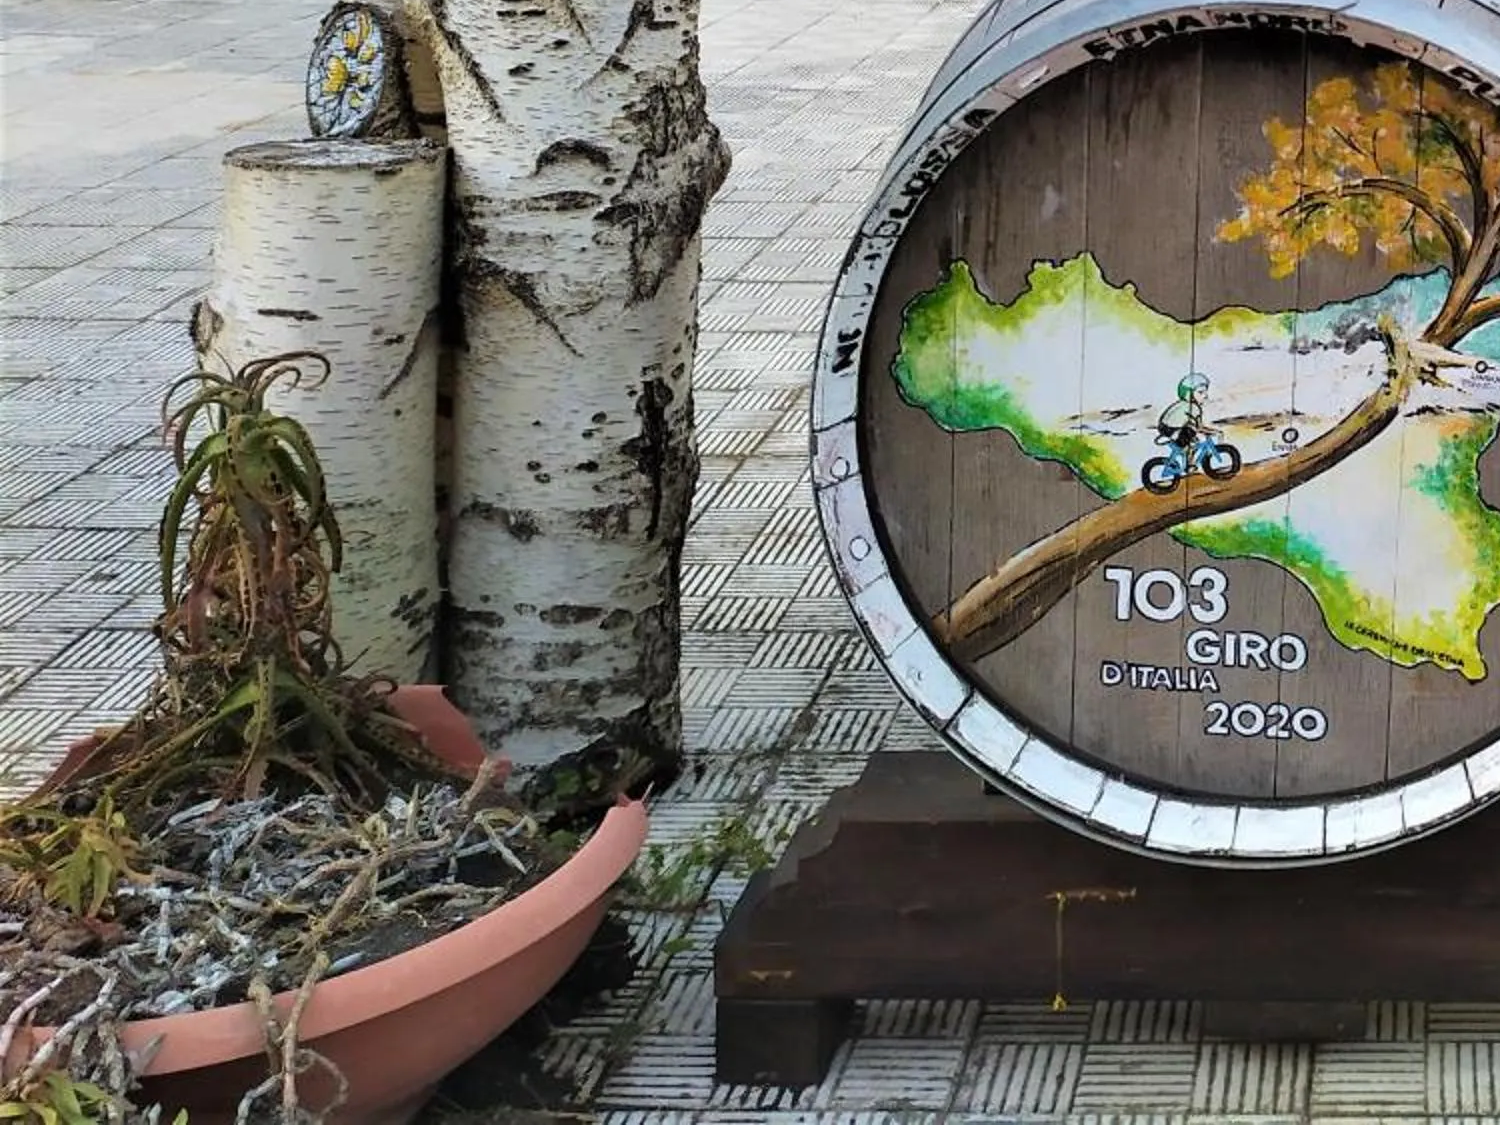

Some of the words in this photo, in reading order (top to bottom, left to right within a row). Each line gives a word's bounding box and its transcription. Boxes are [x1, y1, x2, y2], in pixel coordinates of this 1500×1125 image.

[1104, 565, 1228, 624] 103
[1186, 627, 1308, 672] GIRO
[1101, 661, 1220, 693] D'ITALIA
[1204, 700, 1329, 741] 2020
